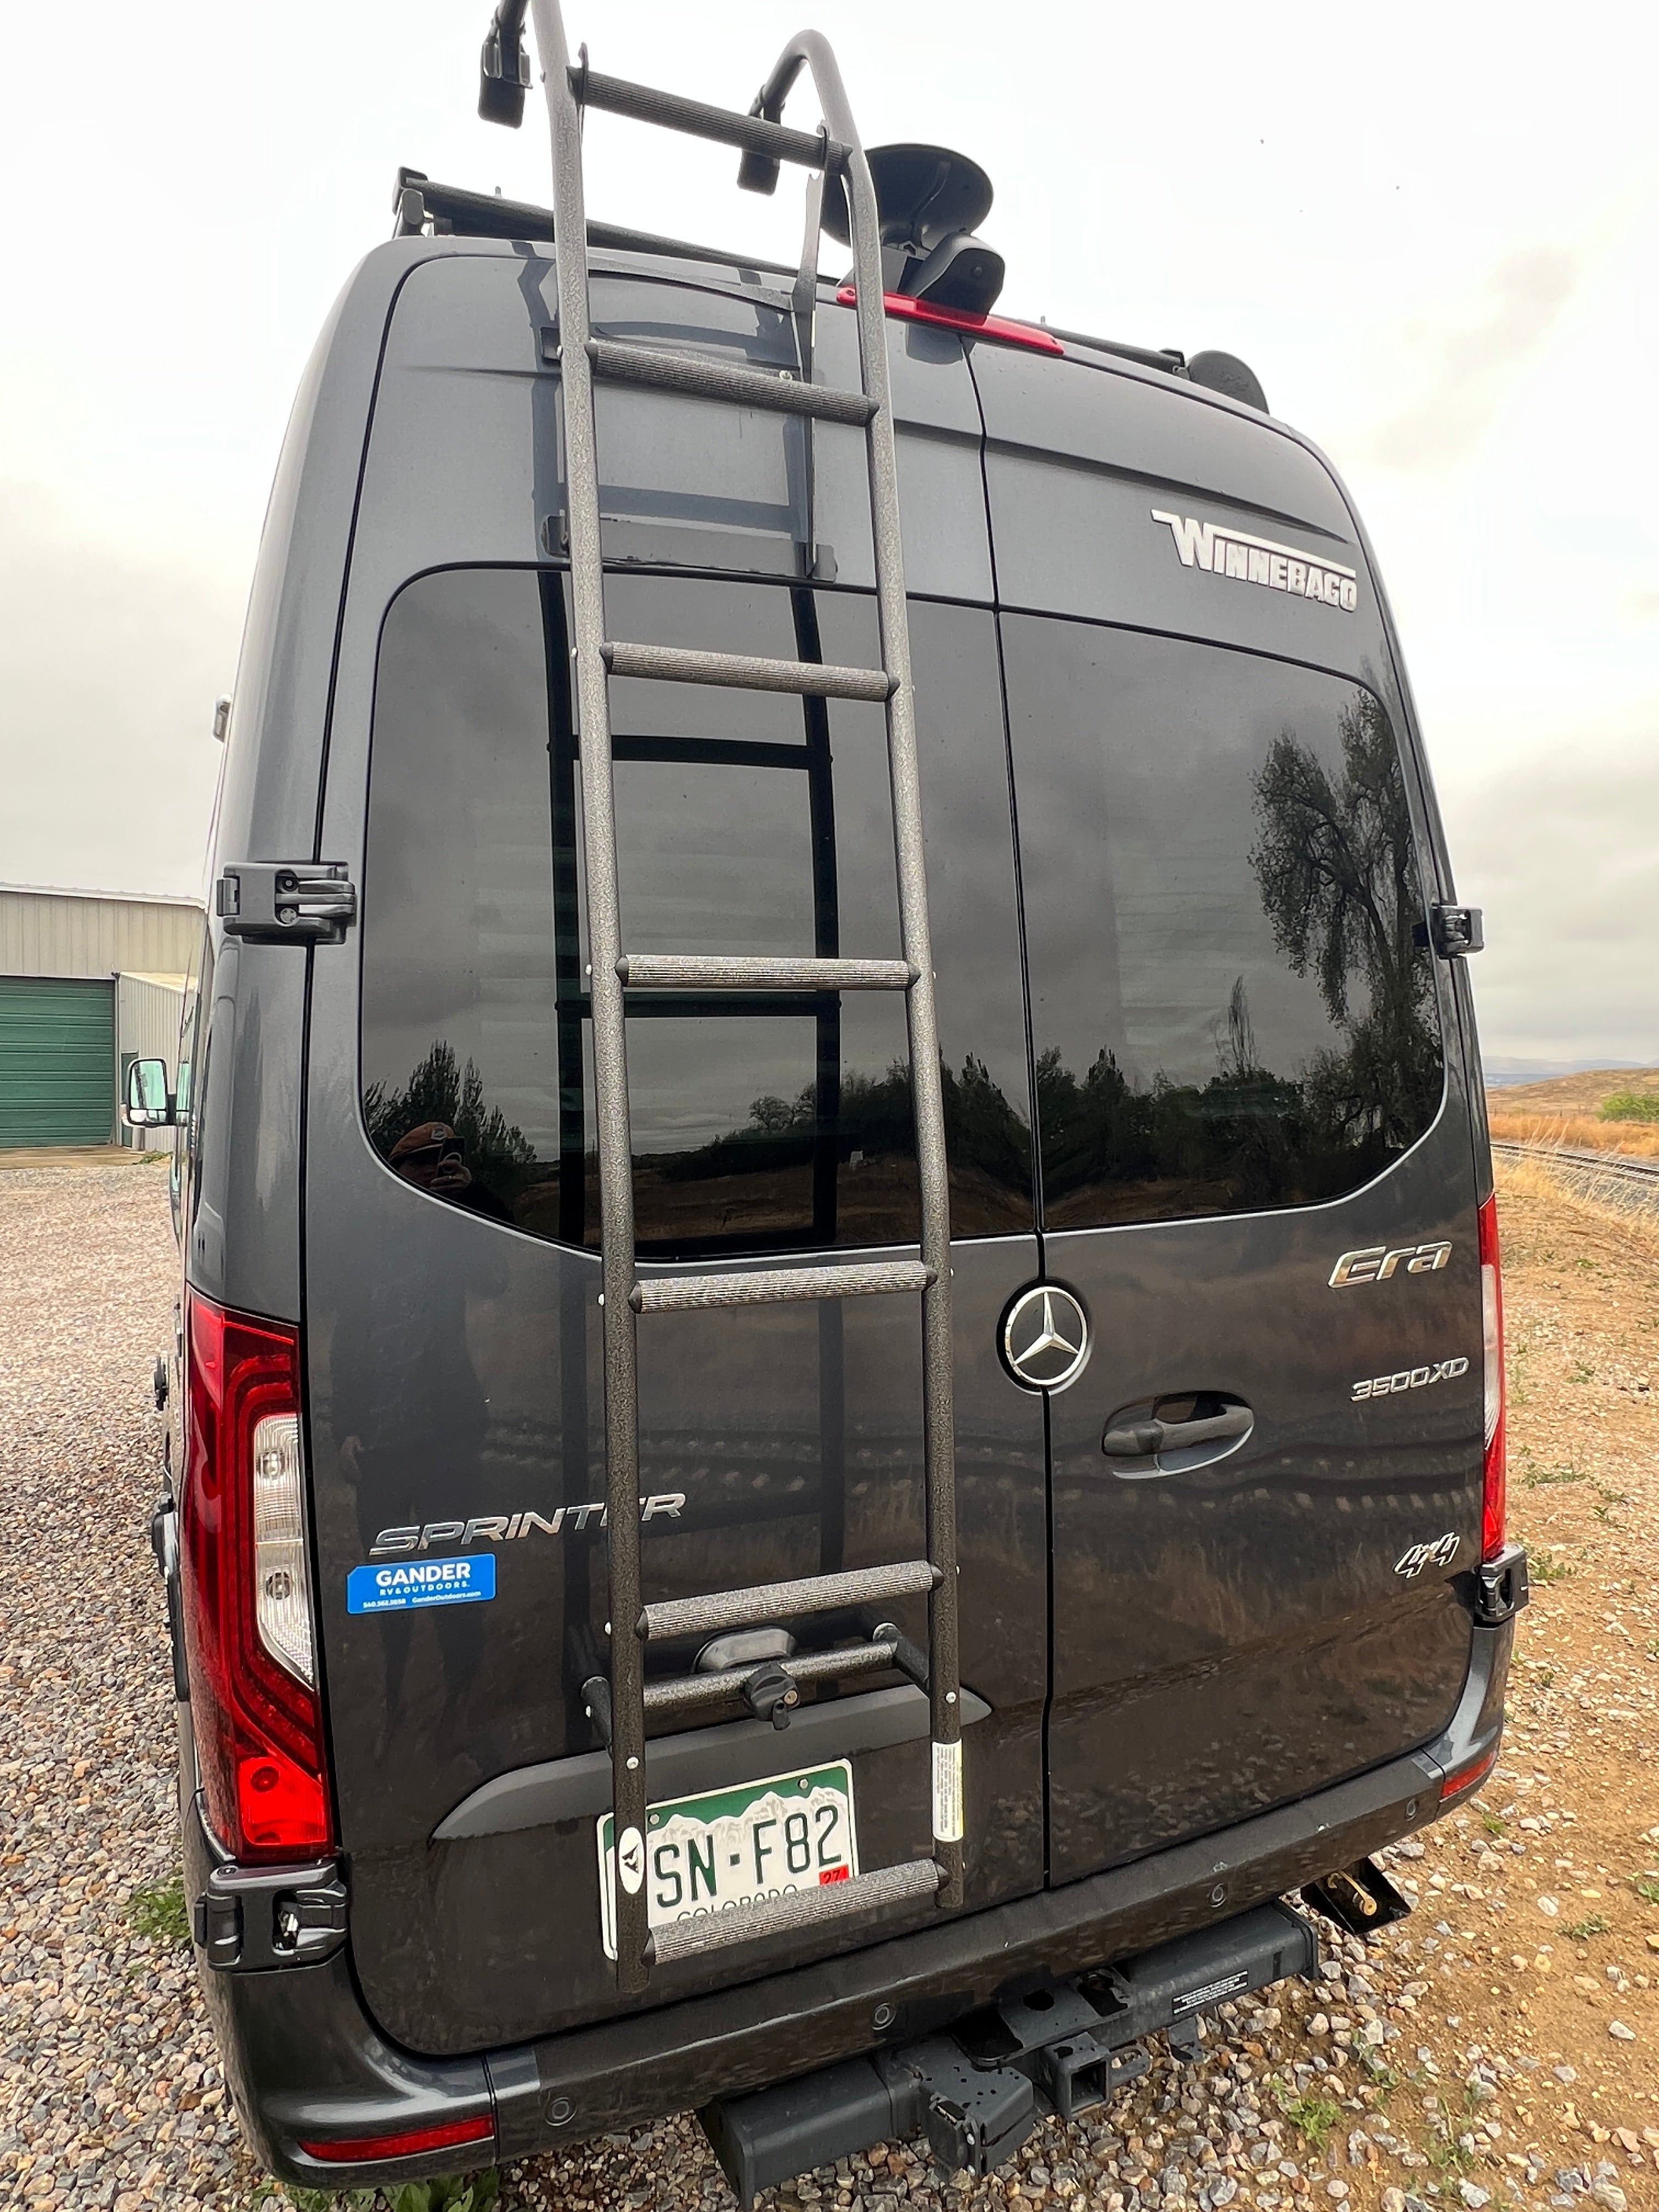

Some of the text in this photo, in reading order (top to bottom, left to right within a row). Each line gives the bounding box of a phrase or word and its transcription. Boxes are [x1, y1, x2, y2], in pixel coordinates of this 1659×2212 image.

[1151, 509, 1357, 612] WINNEBAGO
[1328, 1240, 1453, 1289] Era
[369, 1493, 686, 1556] SPRINTR
[376, 1562, 471, 1587] GANDER
